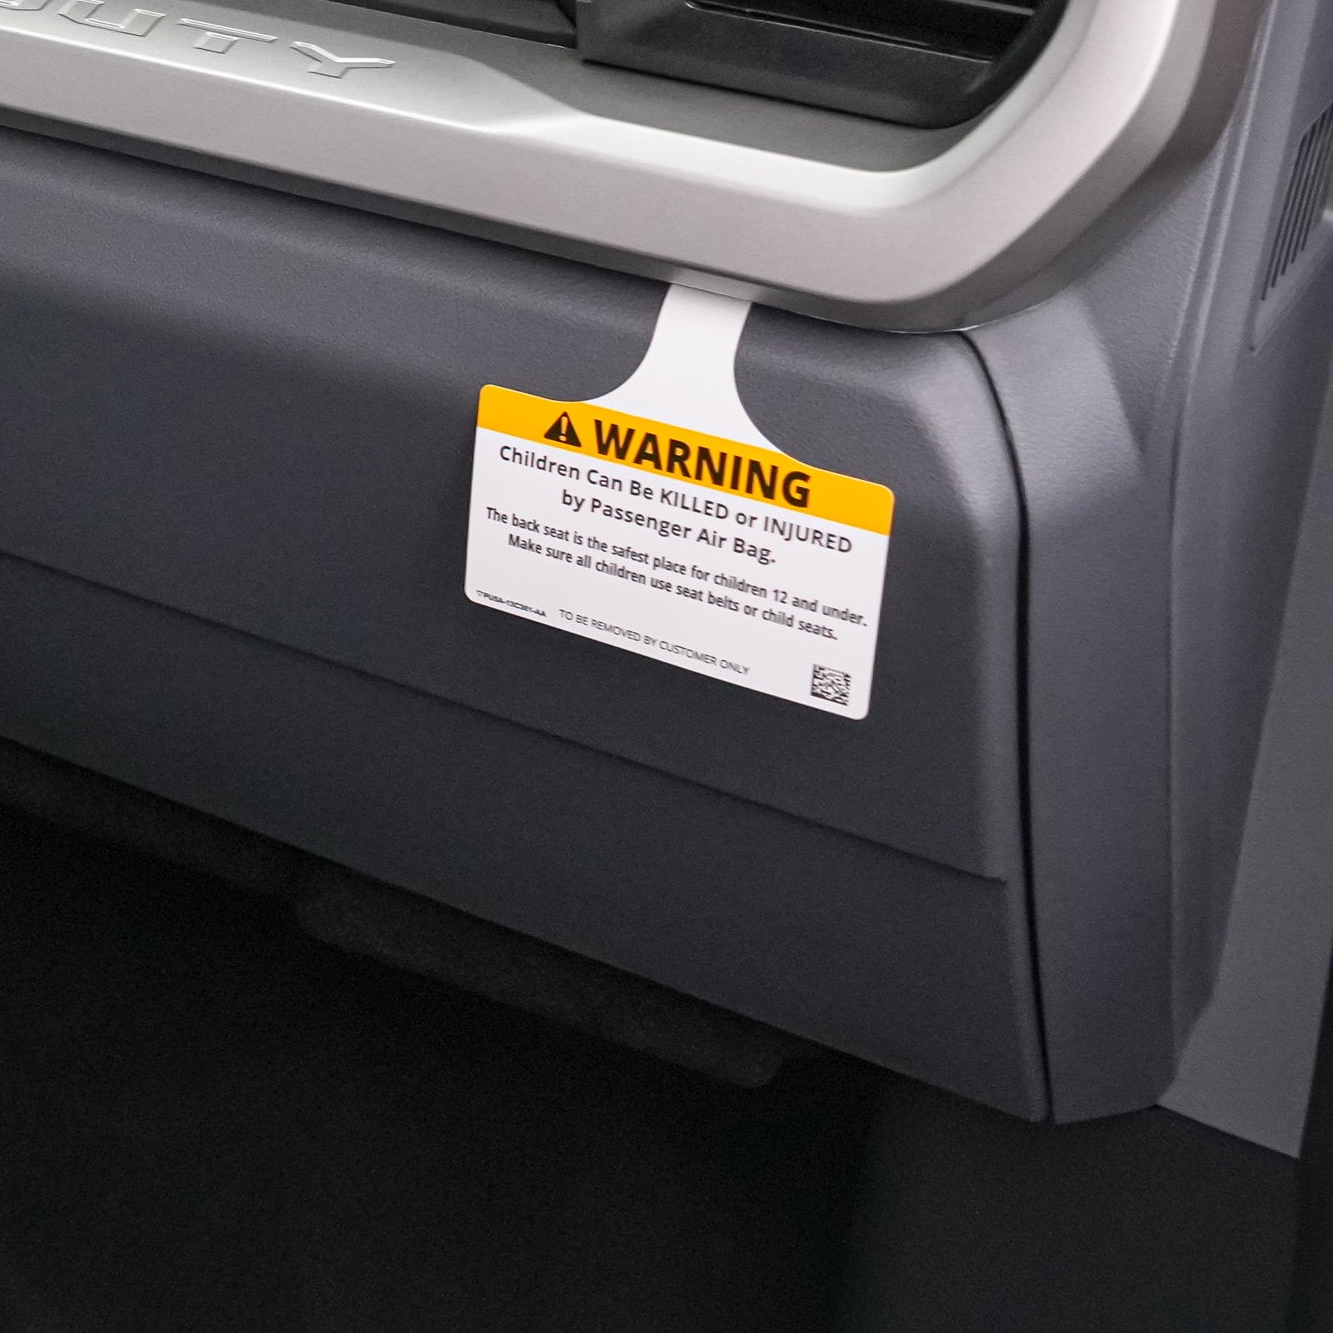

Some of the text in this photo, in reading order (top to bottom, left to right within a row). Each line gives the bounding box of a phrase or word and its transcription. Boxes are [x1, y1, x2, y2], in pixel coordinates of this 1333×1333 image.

[499, 445, 852, 553] Children Can Be KILLED or INJURED
[594, 418, 811, 508] WARNING
[486, 506, 868, 627] The back seat is the safest place for children 12 and under.
[562, 488, 776, 566] by Passenger Air Bag.
[508, 533, 838, 641] Make sure all children use seat belts or child seats.
[559, 608, 751, 675] TO BE REMOVED BY CUSTOMER ONLY
